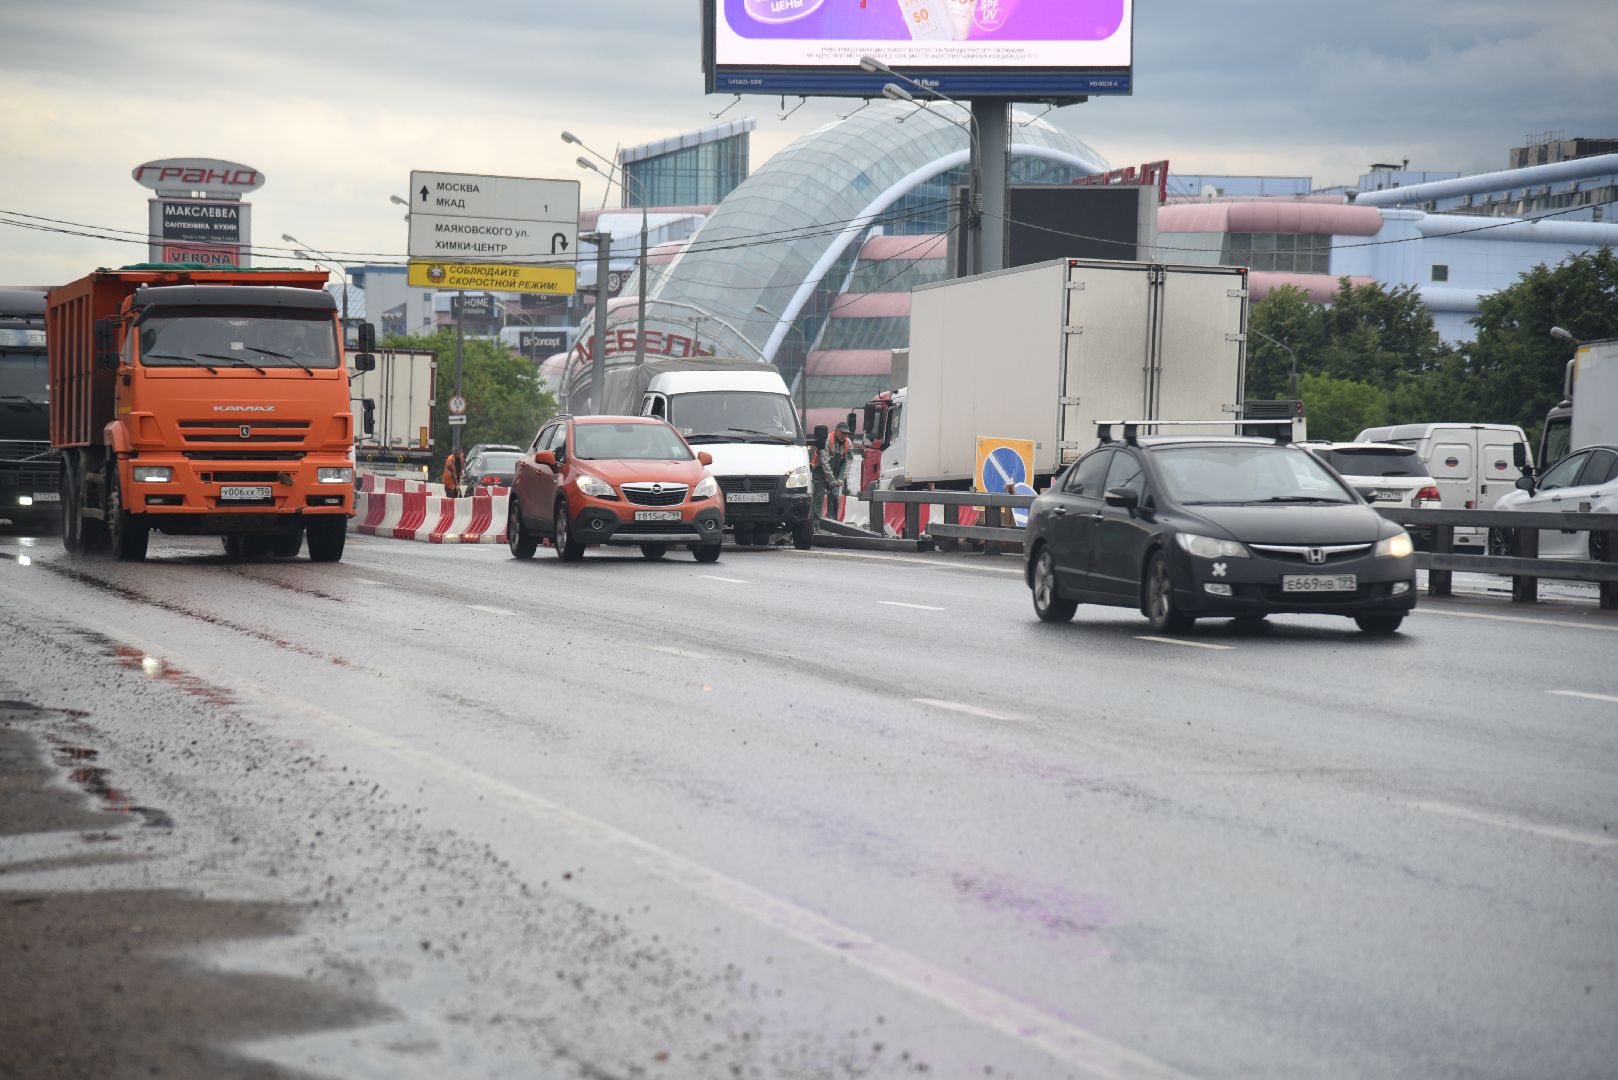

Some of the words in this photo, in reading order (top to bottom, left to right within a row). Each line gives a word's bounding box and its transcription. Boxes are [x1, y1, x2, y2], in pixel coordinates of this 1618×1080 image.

[982, 10, 998, 20] UV
[436, 182, 480, 193] МОСКВА
[165, 205, 237, 218] МАКСЛЕВЕЛ
[436, 198, 466, 209] МКАД
[544, 204, 549, 213] 1
[164, 221, 210, 230] САНТЕХНИКА
[435, 223, 513, 237] МАЯКОВСКОГО
[515, 229, 530, 238] ул.
[435, 241, 508, 253] ХИМКИ-ЦЕНТР
[171, 252, 231, 265] VERONA
[449, 266, 520, 278] СОБЛЮДАЙТЕ
[449, 277, 516, 289] СКОРОСТНОЙ
[518, 281, 558, 291] РЕЖИМ!
[464, 298, 489, 308] HOME
